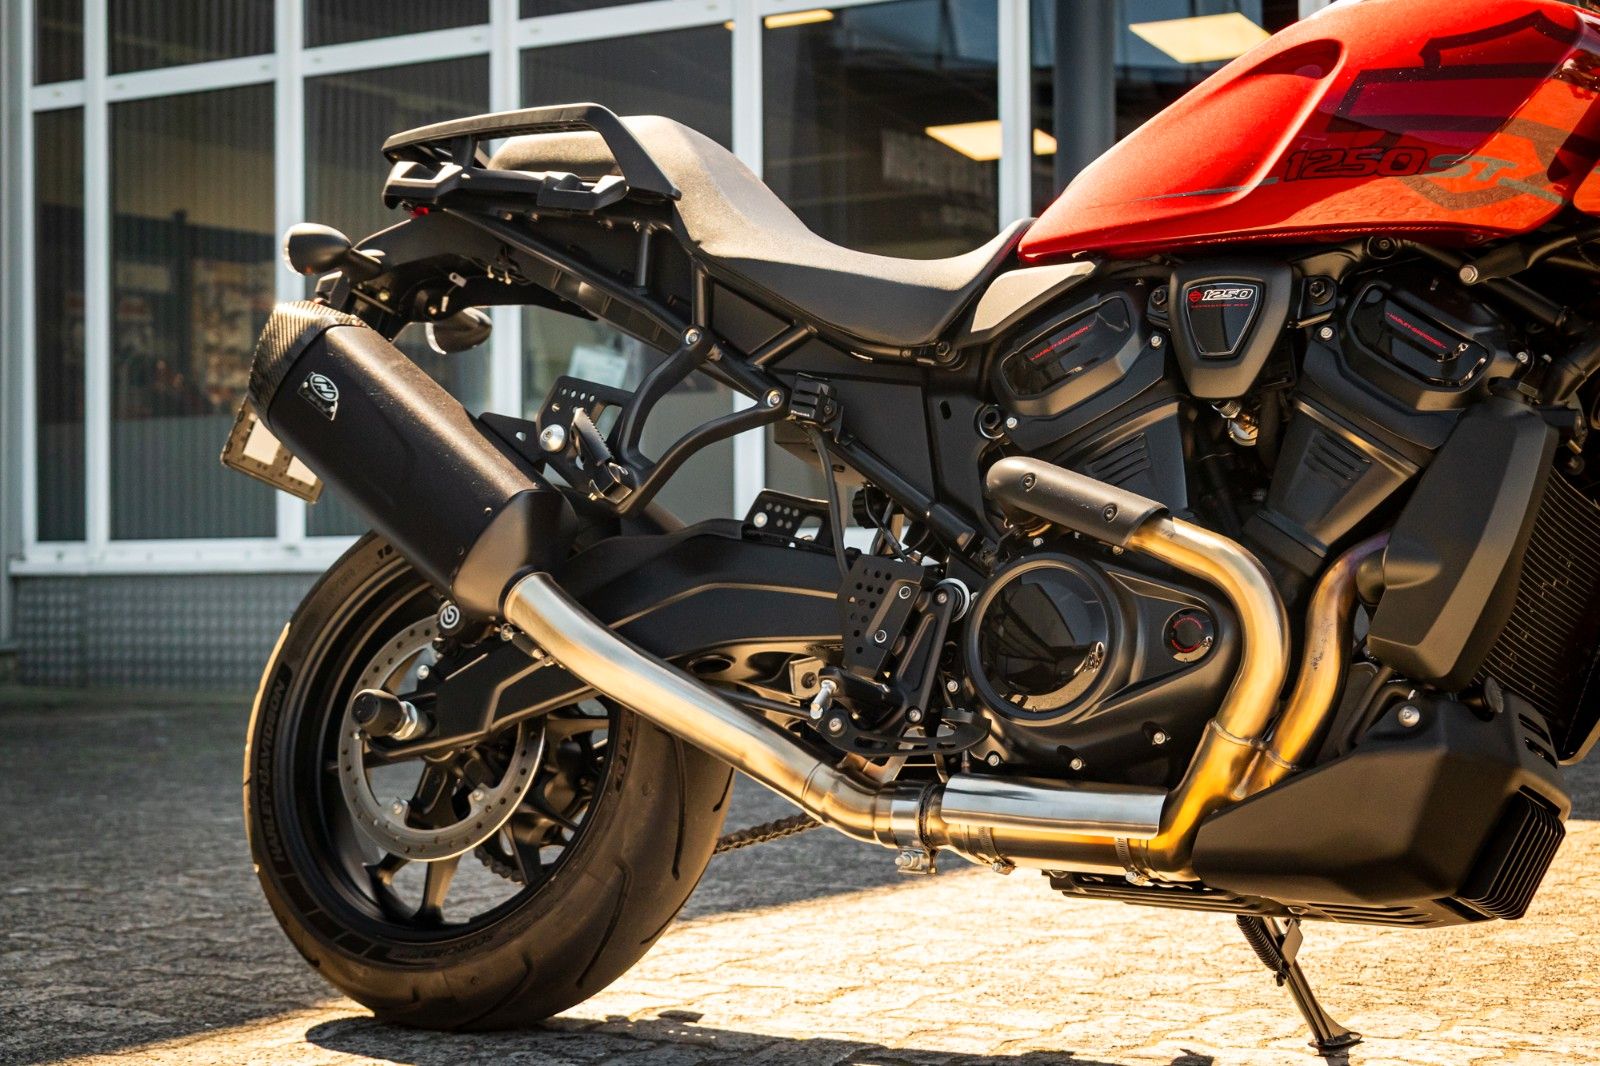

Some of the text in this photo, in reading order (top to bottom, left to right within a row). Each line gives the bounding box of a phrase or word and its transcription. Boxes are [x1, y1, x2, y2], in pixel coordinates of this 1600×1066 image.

[1284, 146, 1428, 183] 1250
[1202, 288, 1254, 301] 1250
[259, 679, 286, 862] HARLEY-DAVIDSON
